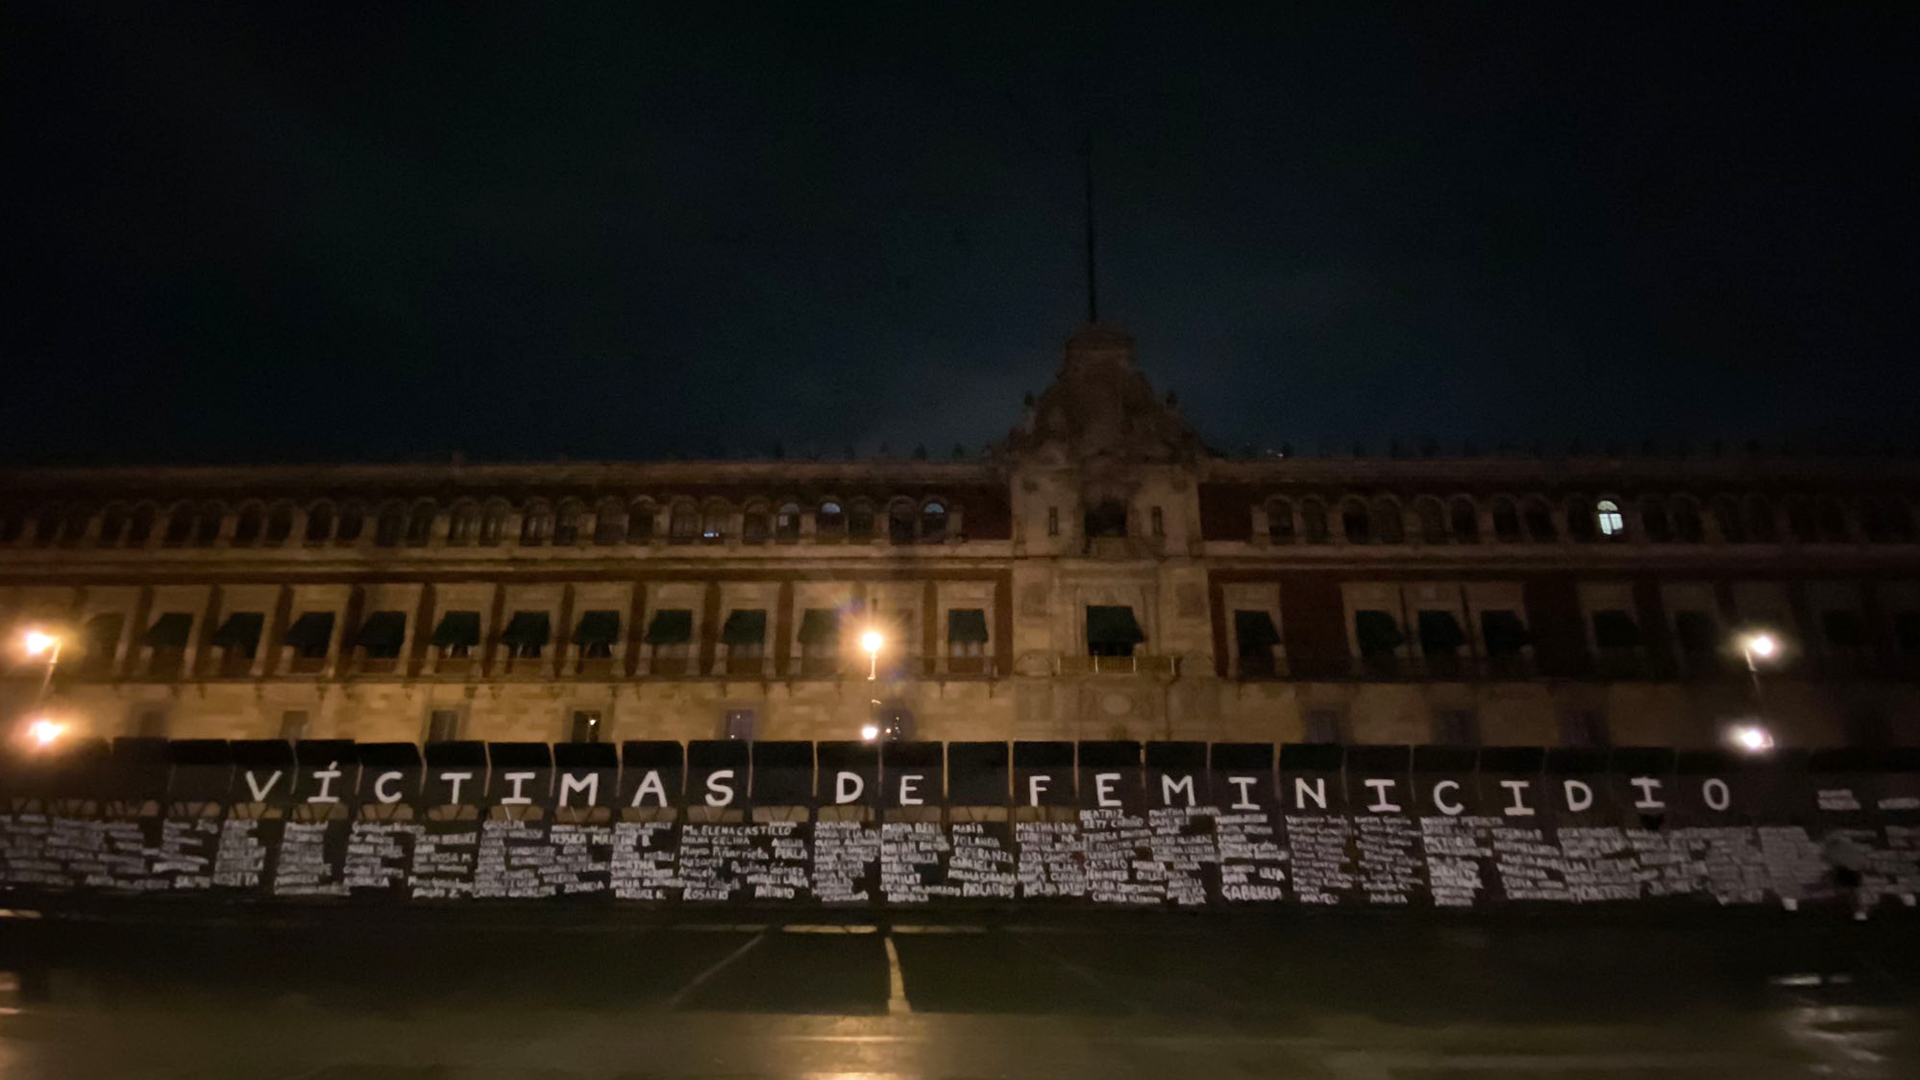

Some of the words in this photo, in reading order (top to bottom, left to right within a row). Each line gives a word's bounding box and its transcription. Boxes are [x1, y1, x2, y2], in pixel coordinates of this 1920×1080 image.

[244, 760, 735, 808] VÍCTIMAS
[835, 771, 924, 807] DE
[1028, 773, 1730, 816] FEMINICIDIO
[1080, 809, 1123, 821] BEATRIZ
[700, 825, 735, 836] ELENA
[736, 825, 792, 836] CASTILLO
[954, 834, 1000, 848] YOLANDA
[1083, 860, 1128, 871] CASTRO
[682, 888, 729, 901] ROSARIO
